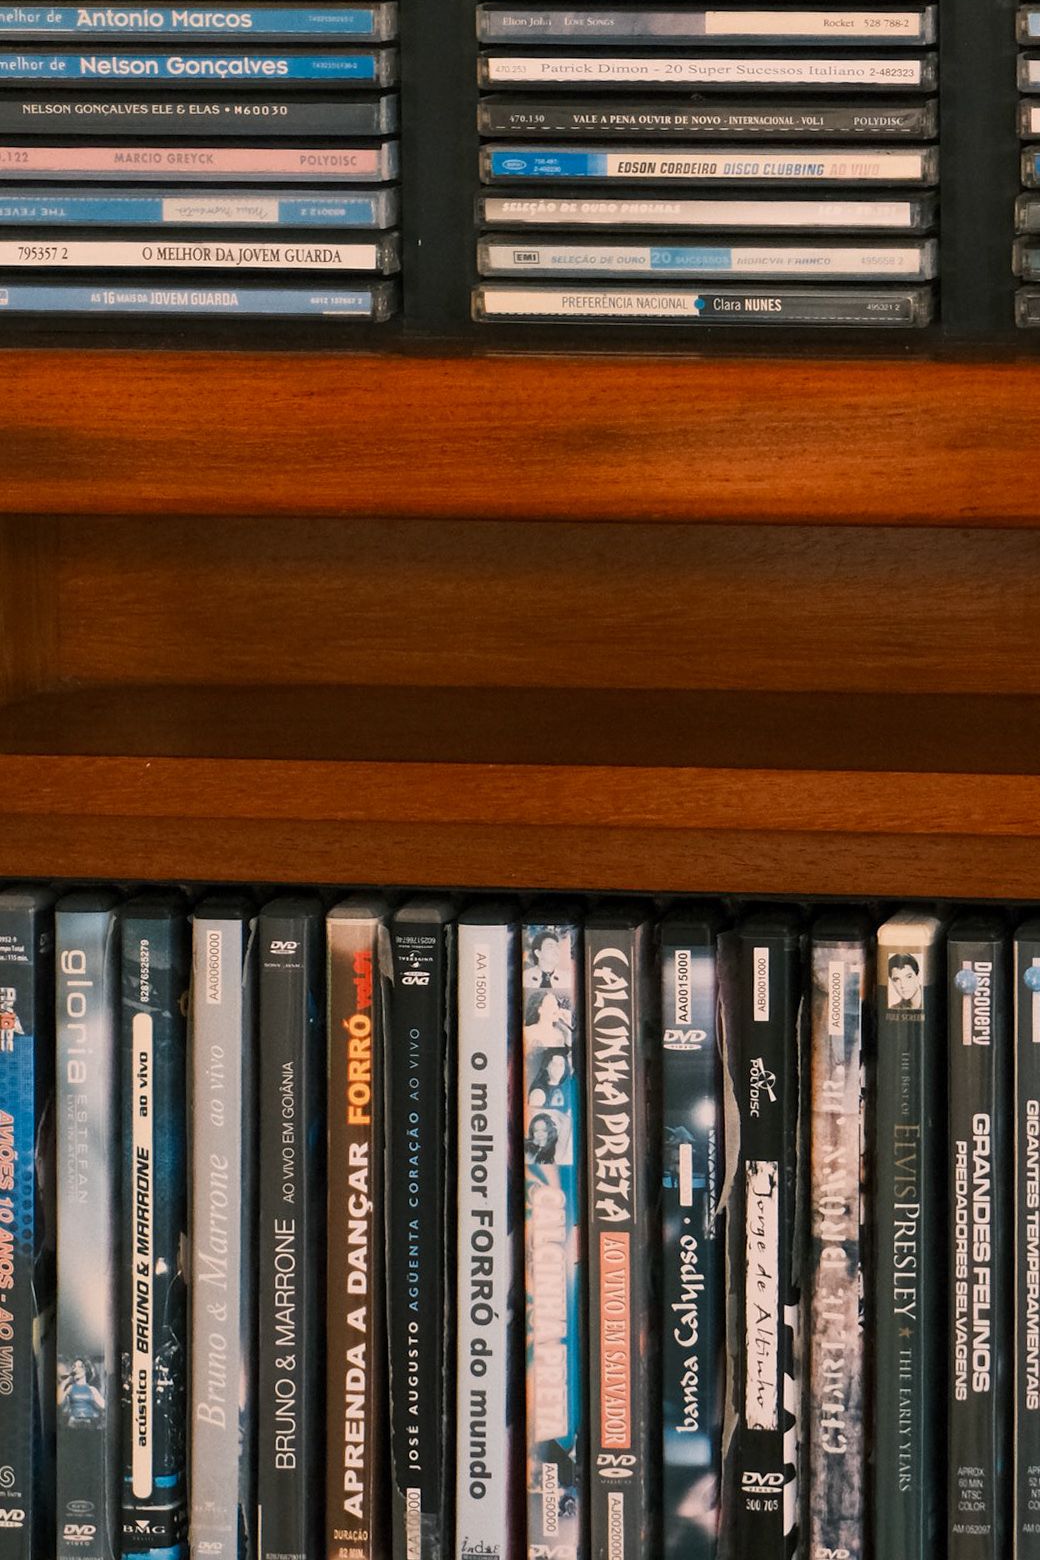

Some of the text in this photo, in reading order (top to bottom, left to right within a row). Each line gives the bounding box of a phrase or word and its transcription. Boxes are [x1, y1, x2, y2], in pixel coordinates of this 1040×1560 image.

[80, 58, 158, 74] Nelson
[167, 57, 288, 78] Gonçalves
[618, 162, 717, 174] EDSON CORDEIRO
[18, 247, 341, 264] 795357 2 O MELHOR DA JOVEM GUARDA
[713, 298, 781, 311] Clara NUNES
[62, 949, 87, 1085] gloria
[275, 1061, 295, 1470] BRUNO & MARRONE AO VIVO EM GOIÂNIA
[342, 1013, 374, 1519] APRENDA A DANÇAR FORRÓ
[469, 1051, 500, 1500] o melhor FORRÓ do mundo
[972, 1112, 990, 1393] GRANDES FELINOS
[122, 1524, 166, 1535] BMG
